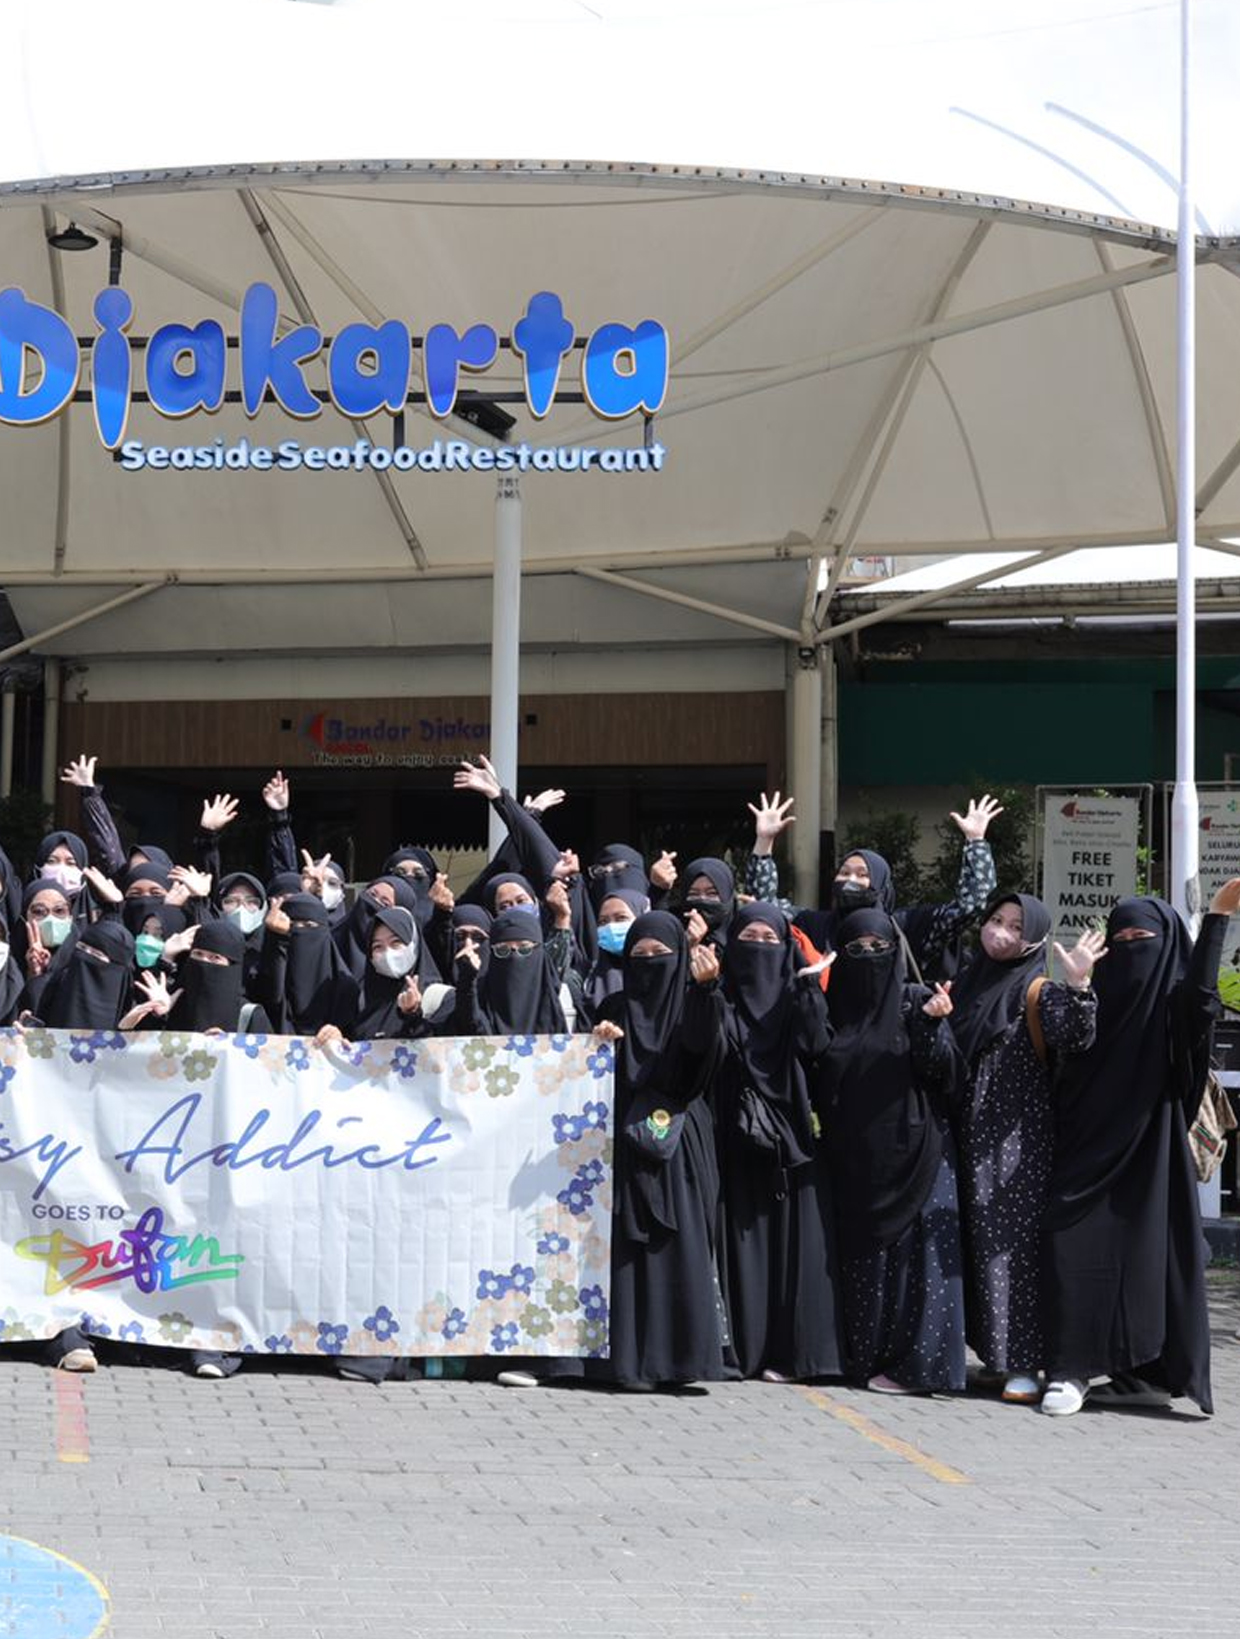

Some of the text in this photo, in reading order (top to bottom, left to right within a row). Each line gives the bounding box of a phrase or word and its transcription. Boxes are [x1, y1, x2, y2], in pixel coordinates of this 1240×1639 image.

[327, 718, 410, 741] Bandar
[1073, 850, 1112, 866] FREE
[1068, 871, 1115, 887] TIKET
[1059, 892, 1121, 909] MASUK
[114, 1091, 453, 1185] Addict
[31, 1203, 125, 1221] GOES TO
[13, 1205, 246, 1297] Dufan
